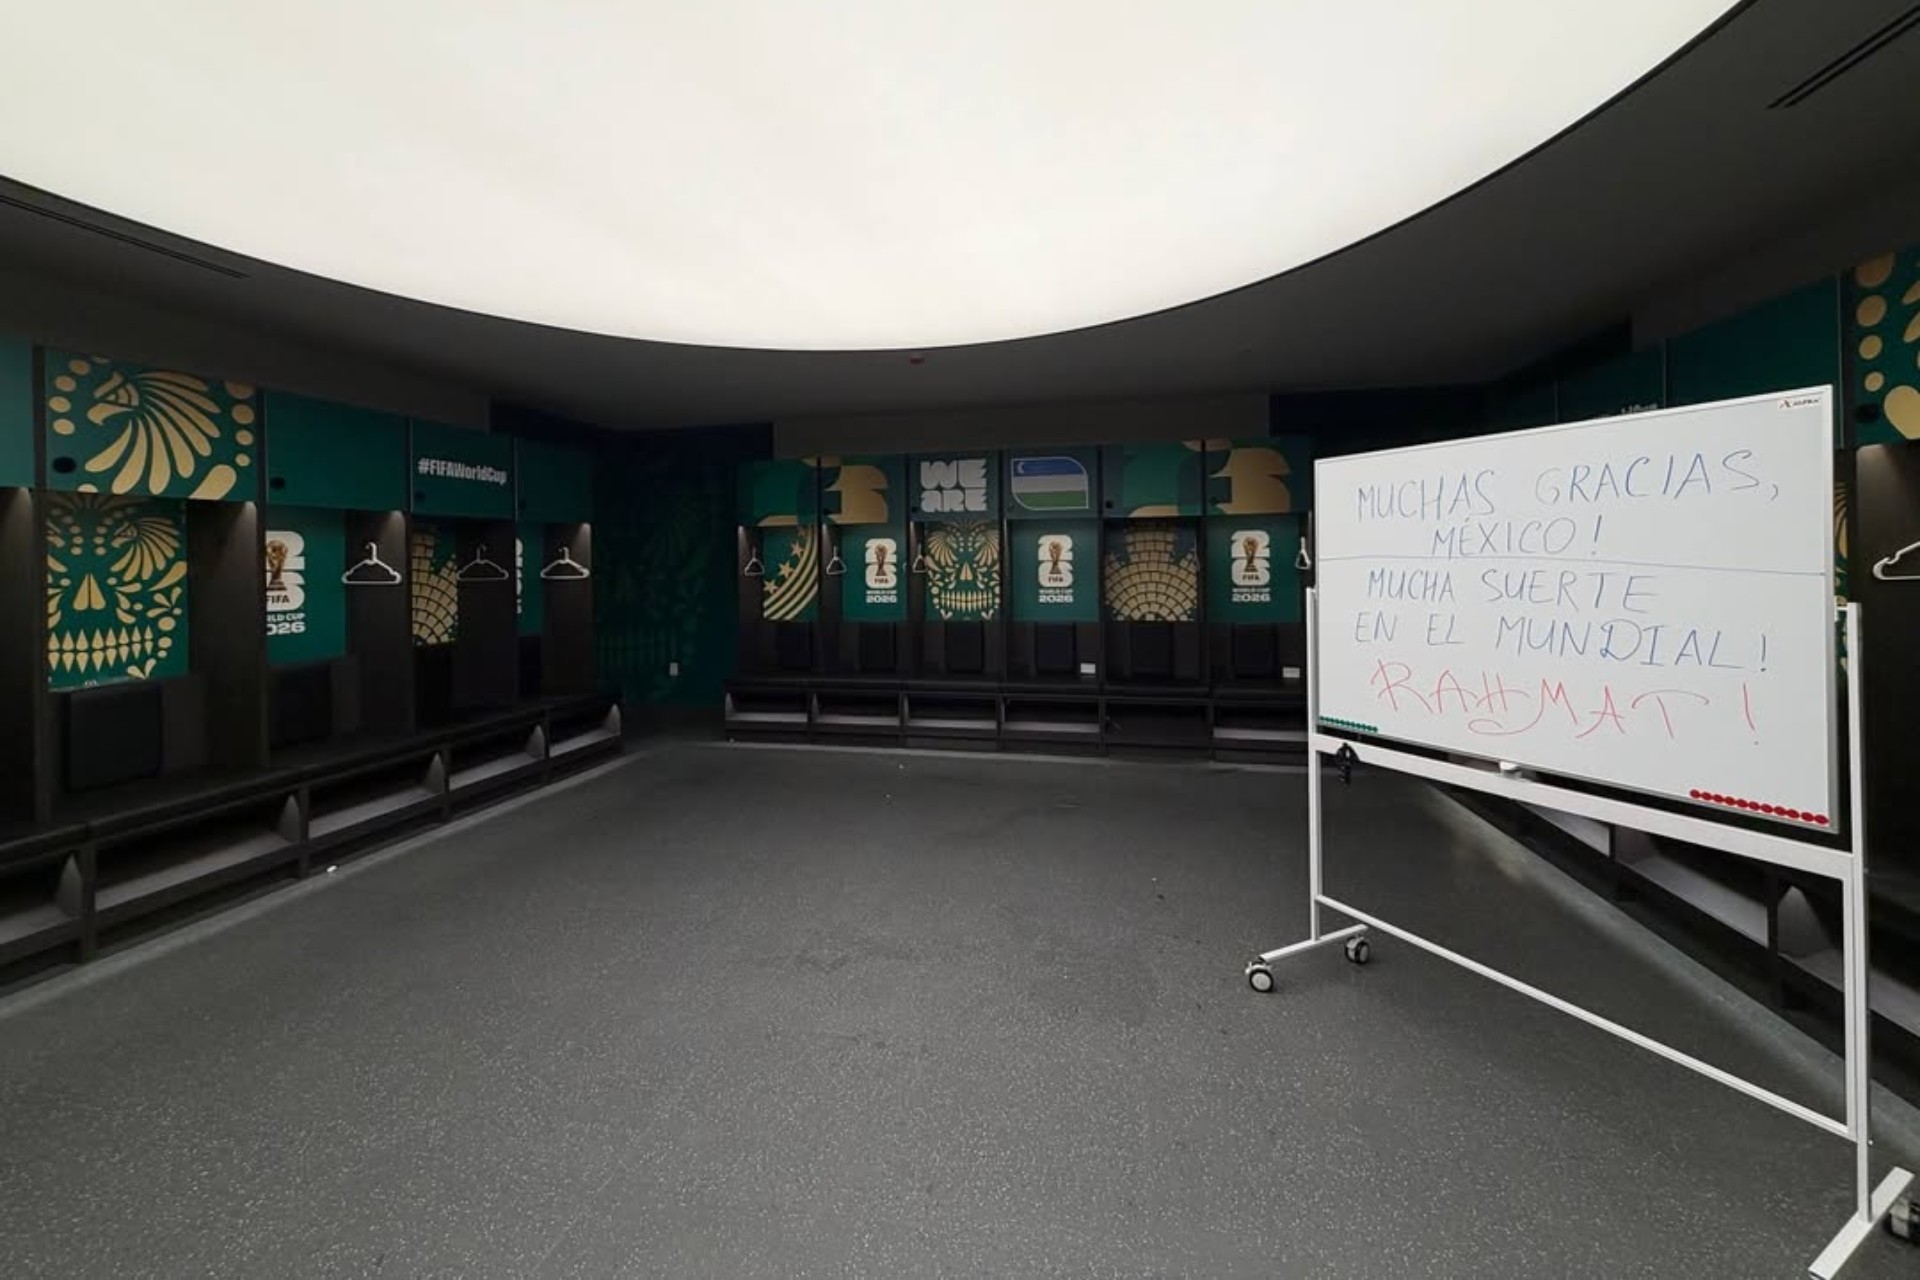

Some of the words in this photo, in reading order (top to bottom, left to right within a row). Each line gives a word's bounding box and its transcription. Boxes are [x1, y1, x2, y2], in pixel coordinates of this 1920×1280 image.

[418, 458, 507, 486] #FIFAWorldCup
[920, 459, 987, 490] WE
[1358, 469, 1495, 523] MUCHAS
[1536, 449, 1779, 504] GRACIAS,
[1038, 595, 1073, 603] 2026
[1232, 594, 1271, 602] 2026
[1368, 568, 1456, 603] MUCHA
[1481, 568, 1658, 614] SUERTE
[266, 622, 306, 635] 026
[1355, 611, 1398, 644] EN
[1427, 613, 1465, 646] EL
